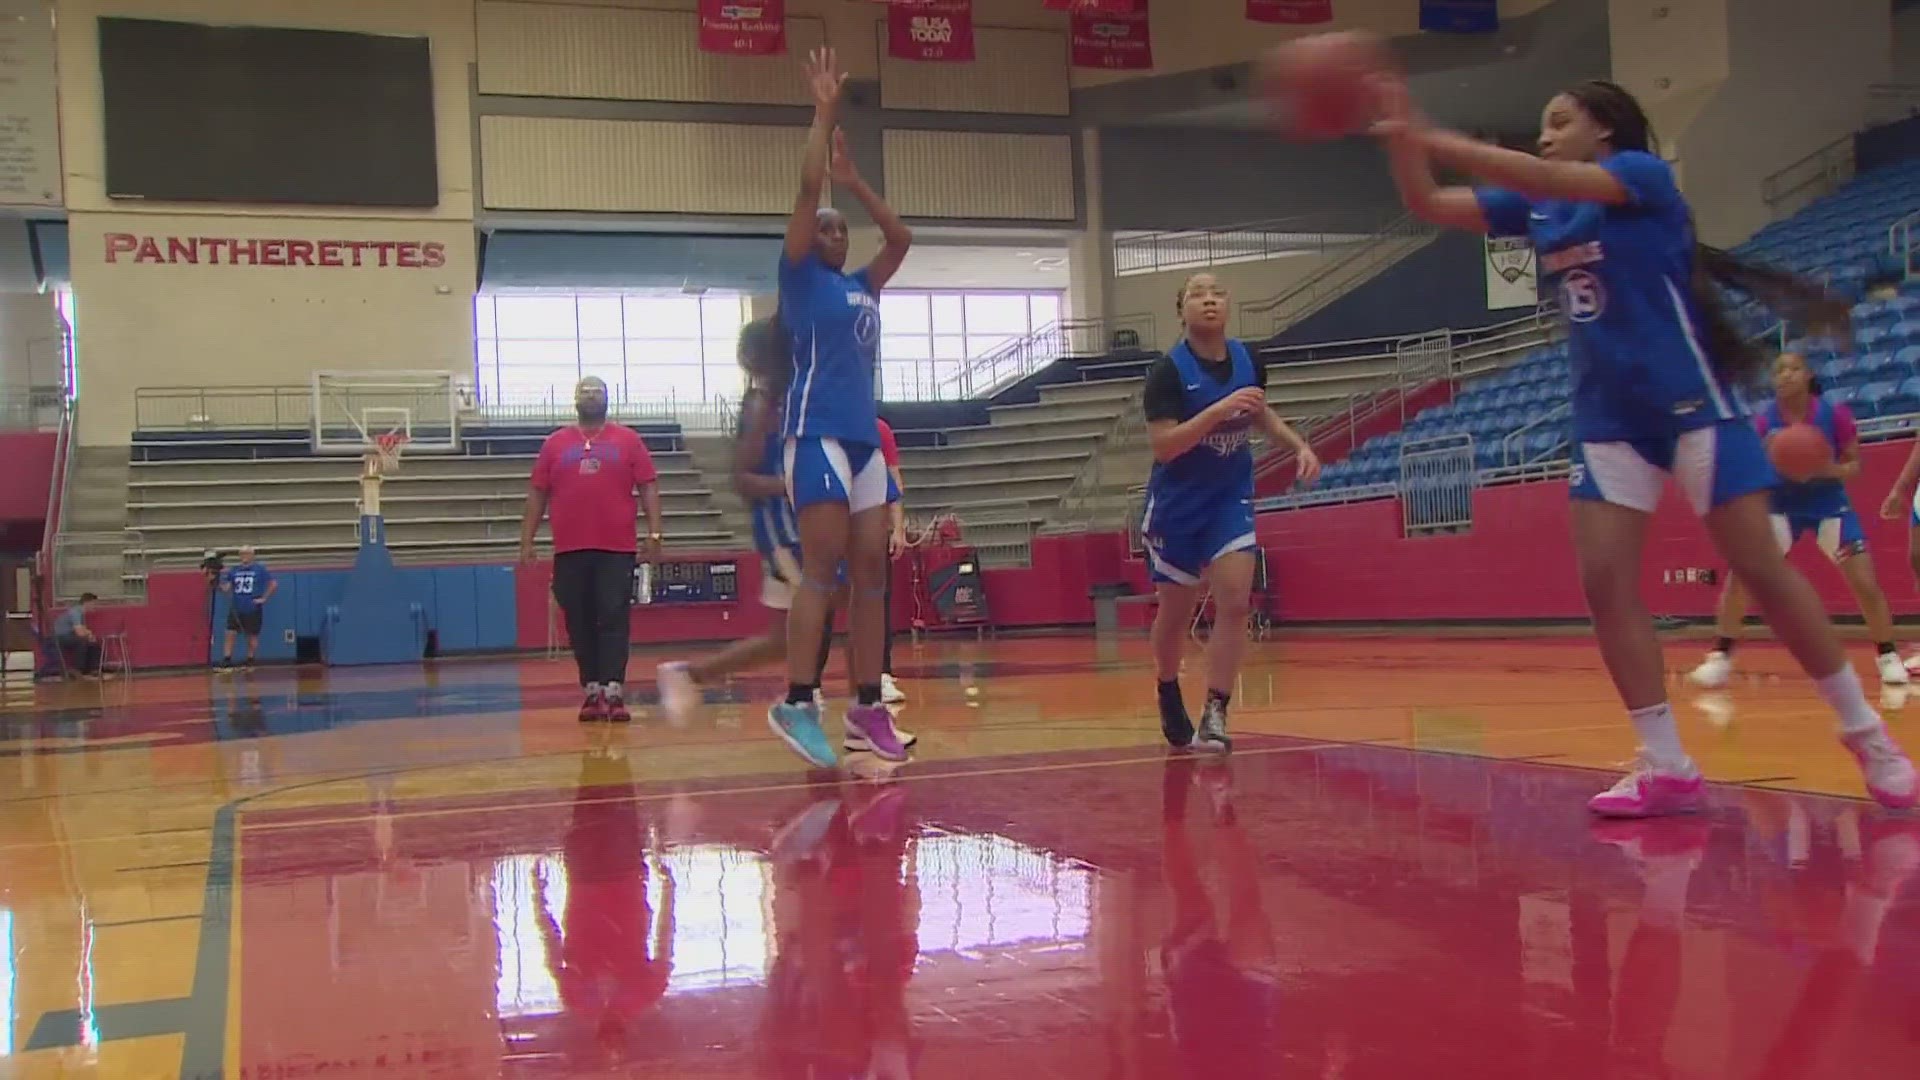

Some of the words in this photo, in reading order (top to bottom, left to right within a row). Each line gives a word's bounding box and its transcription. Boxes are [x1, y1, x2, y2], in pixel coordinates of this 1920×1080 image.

[923, 16, 950, 28] USA
[911, 28, 952, 43] TODAY
[104, 232, 446, 268] PANTHERETTES
[234, 576, 254, 593] 33
